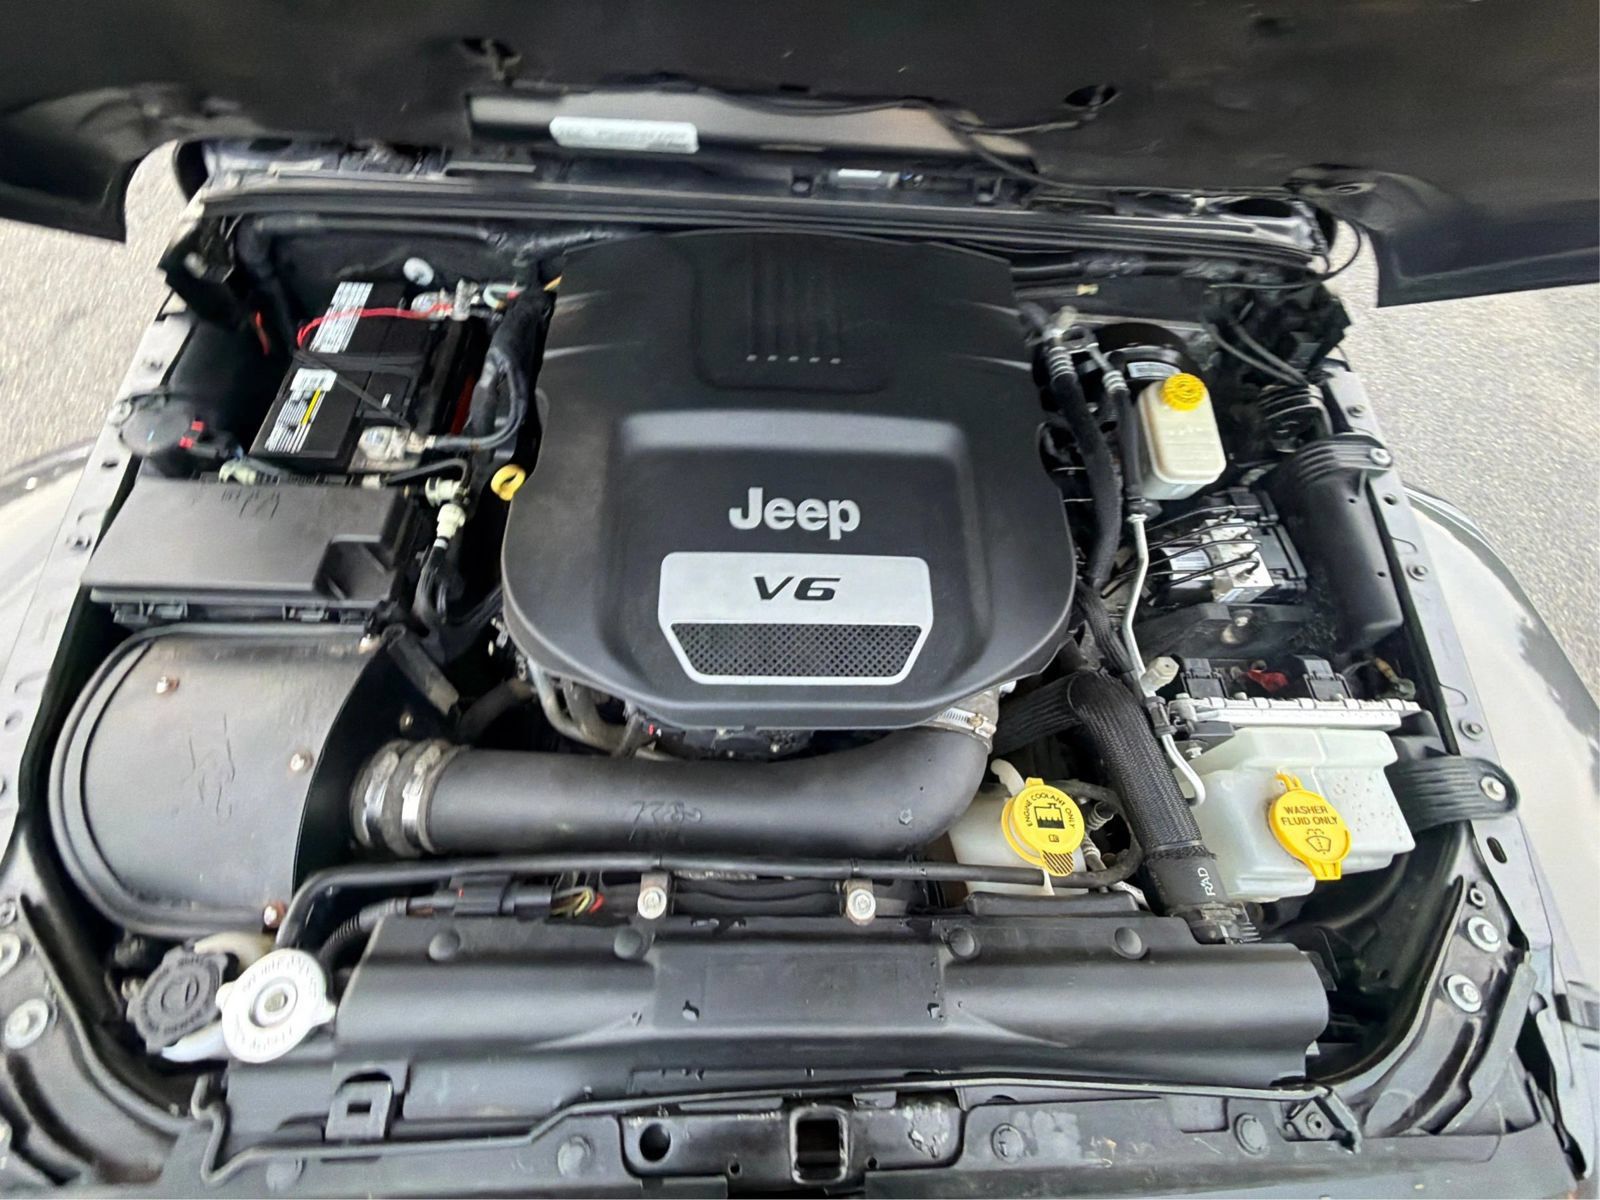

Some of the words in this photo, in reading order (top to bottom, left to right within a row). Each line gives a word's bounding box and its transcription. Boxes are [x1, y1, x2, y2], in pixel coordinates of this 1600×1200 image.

[728, 486, 860, 540] Jeep
[753, 576, 841, 601] V6
[1023, 799, 1033, 827] ENGINE
[1031, 792, 1066, 807] COOLANT
[1065, 808, 1076, 829] ONLY
[1280, 816, 1311, 826] FLUID
[1312, 816, 1338, 825] ONLY
[1283, 805, 1328, 815] WASHER
[1197, 867, 1216, 896] RAD
